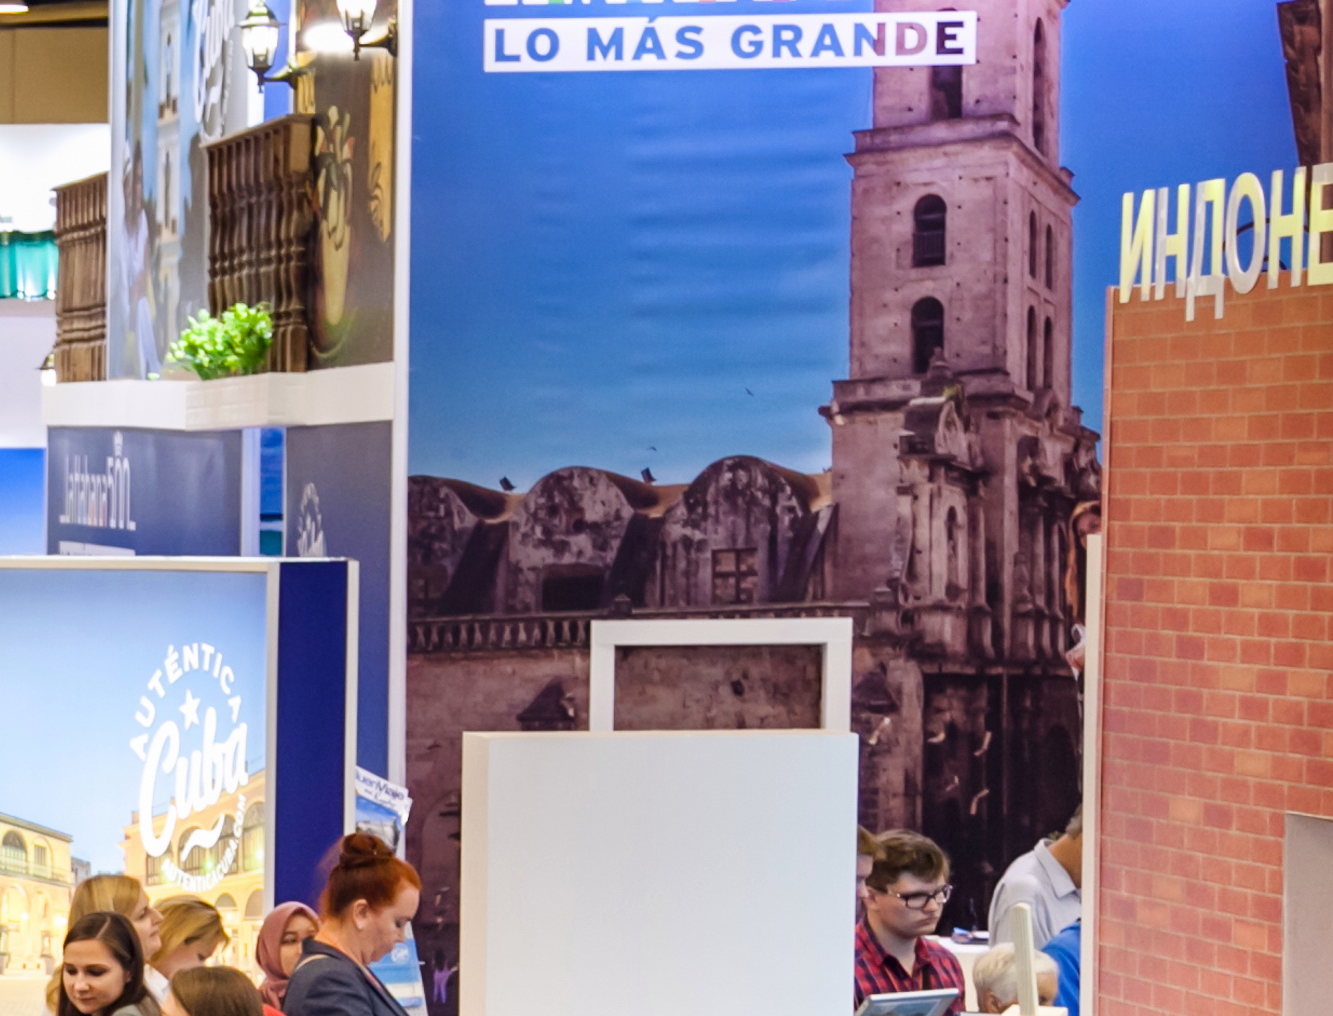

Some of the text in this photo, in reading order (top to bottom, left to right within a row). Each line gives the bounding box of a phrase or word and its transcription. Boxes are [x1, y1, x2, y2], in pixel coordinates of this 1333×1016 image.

[494, 17, 965, 63] LO MÁS GRANDE
[1119, 163, 1333, 322] ИНДОНЕ
[138, 706, 249, 858] Cuba
